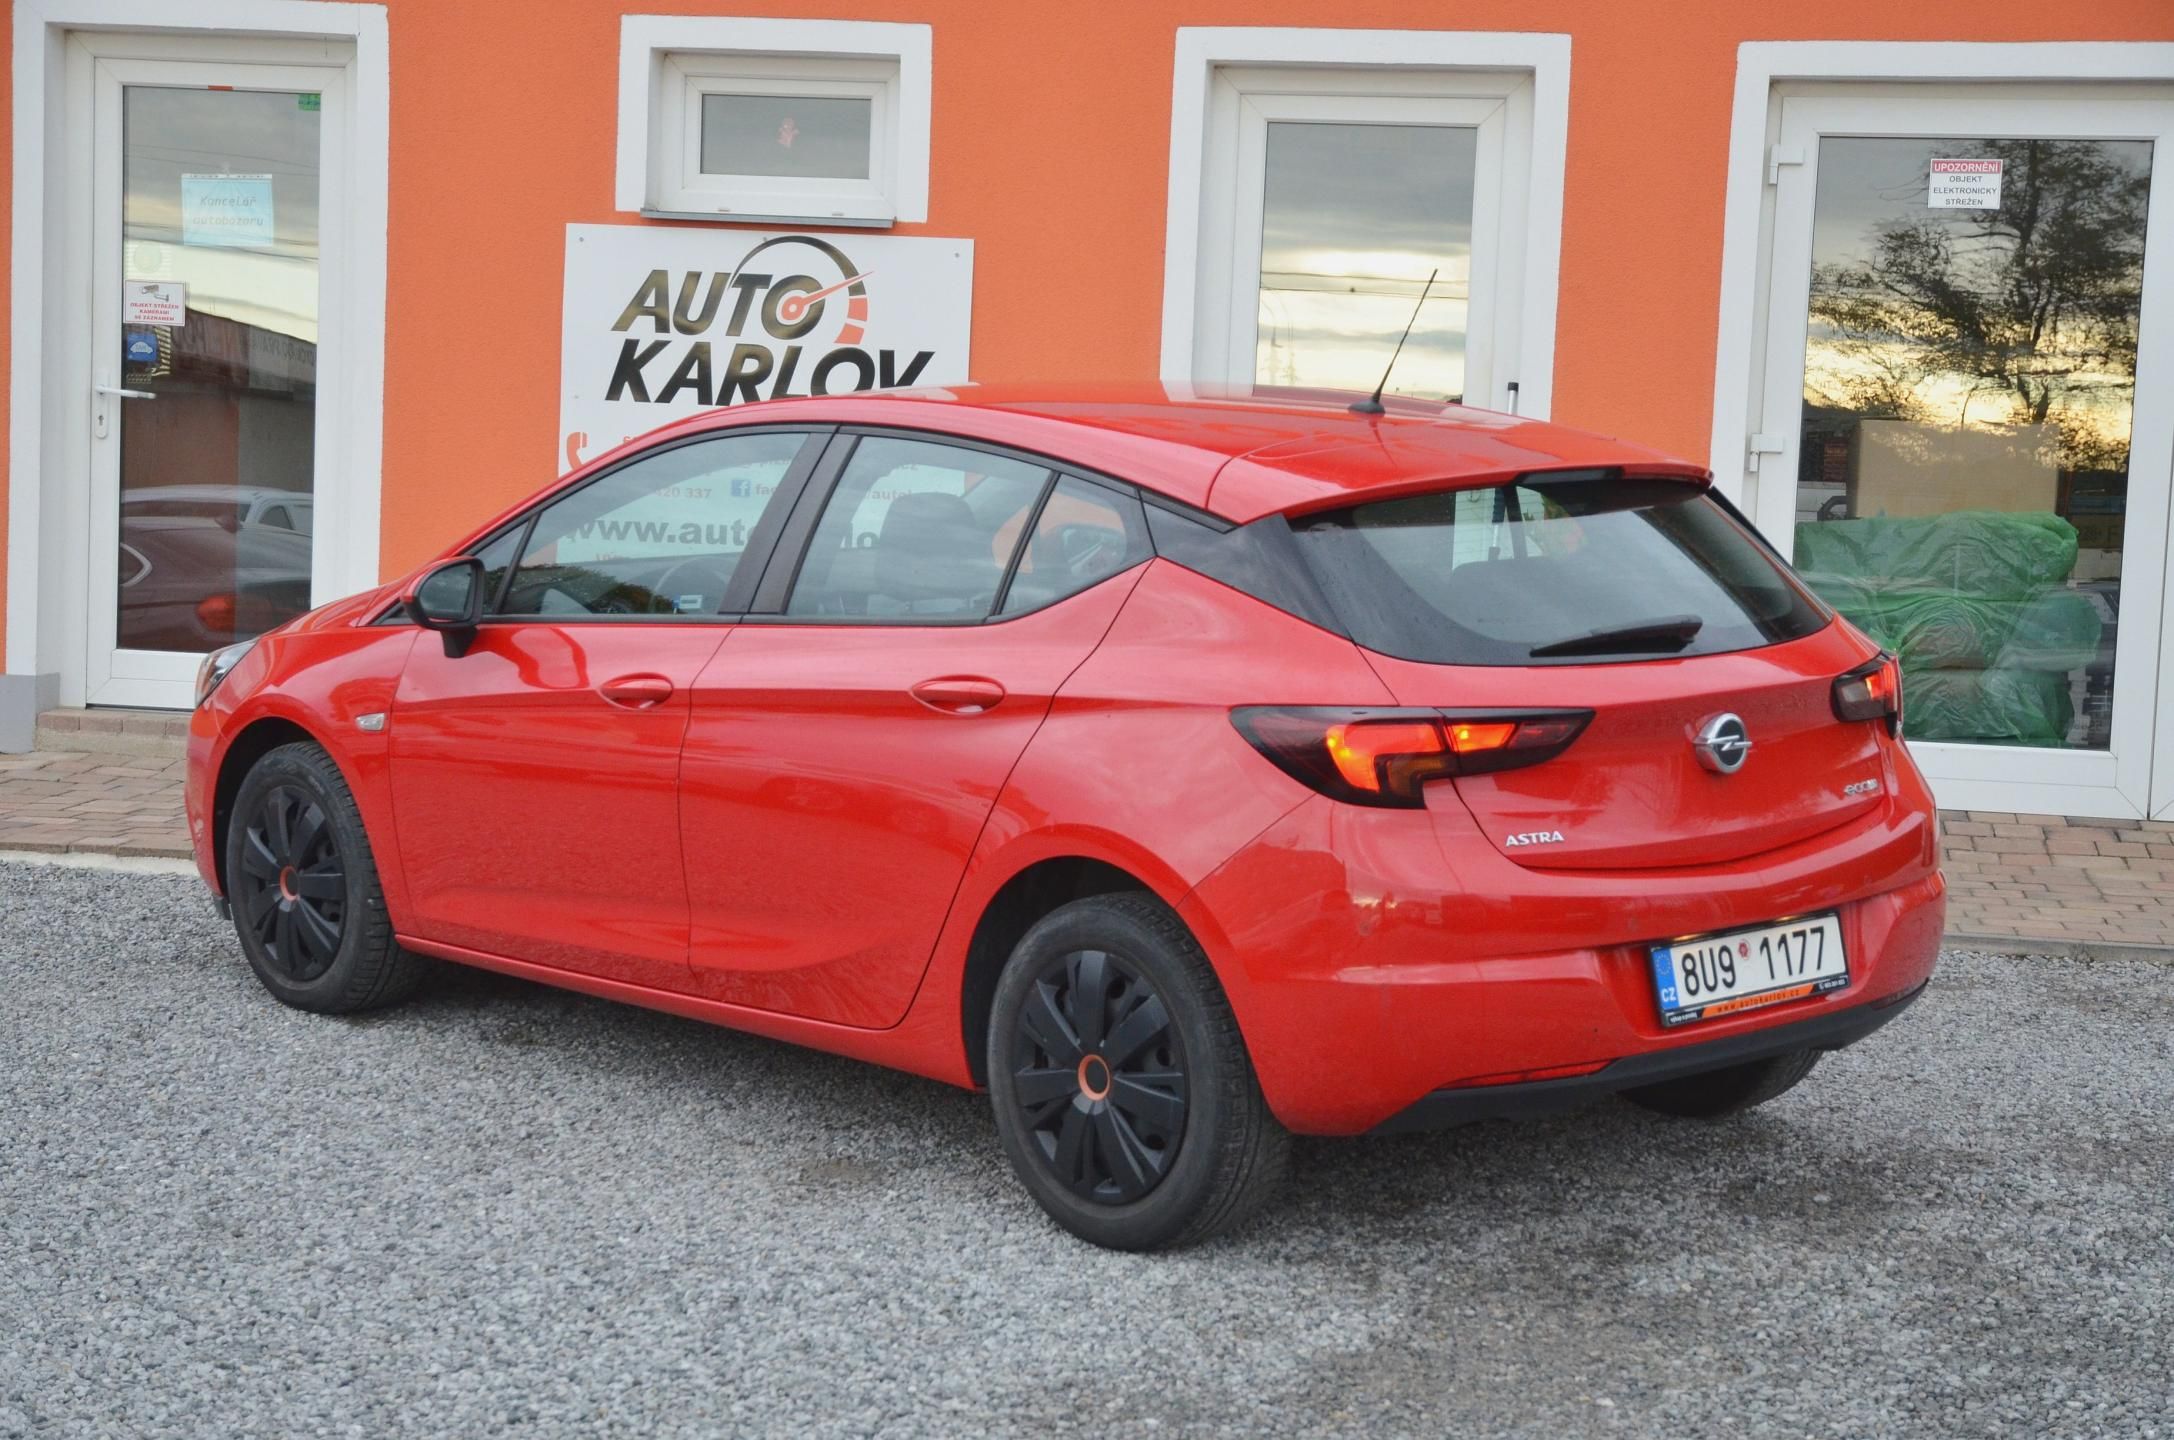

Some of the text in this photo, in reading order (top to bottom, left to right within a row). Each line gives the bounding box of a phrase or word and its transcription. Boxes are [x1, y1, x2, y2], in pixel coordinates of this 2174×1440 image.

[1934, 161, 1998, 172] UPOZORNĚNÍ
[1949, 175, 1983, 183] OBJEKT
[610, 269, 826, 340] AUTO
[605, 338, 936, 406] KARLOV
[1505, 830, 1565, 847] ASTRA
[1660, 925, 1825, 1003] CZ 8U9 1177
